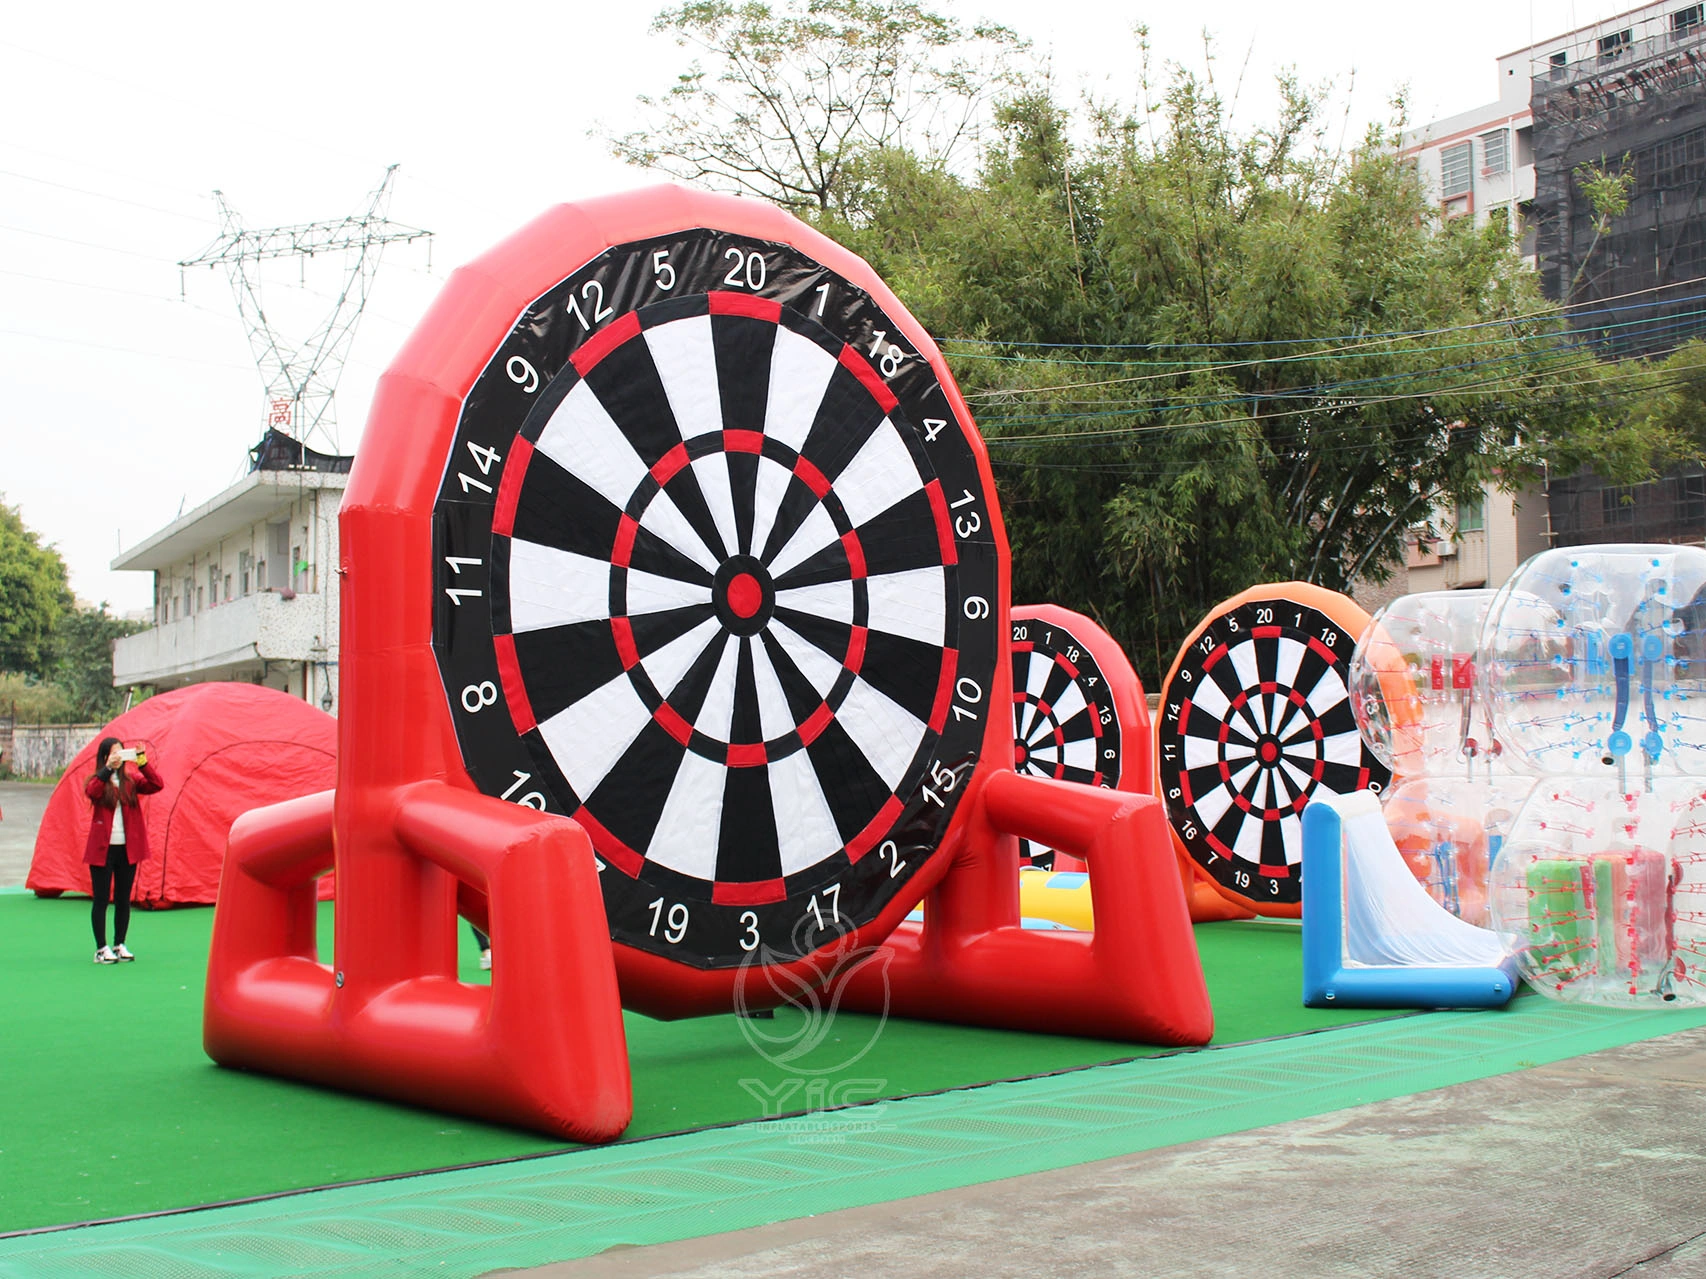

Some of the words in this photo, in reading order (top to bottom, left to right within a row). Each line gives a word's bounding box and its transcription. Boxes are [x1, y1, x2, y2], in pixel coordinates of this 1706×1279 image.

[654, 250, 675, 290] 5
[724, 248, 766, 290] 20
[567, 280, 613, 330] 12
[815, 283, 830, 317] 1
[869, 330, 903, 378] 18
[507, 356, 538, 393] 9
[923, 419, 947, 441] 4
[458, 441, 501, 493] 14
[951, 490, 980, 538] 13
[446, 557, 482, 605] 11
[964, 596, 989, 619] 6
[1256, 607, 1273, 624] 20
[1228, 617, 1239, 633] 5
[1294, 612, 1302, 628] 1
[1013, 626, 1028, 641] 20
[1045, 631, 1052, 645] 1
[1320, 627, 1337, 647] 18
[1065, 645, 1080, 664] 18
[1199, 635, 1216, 655] 12
[1087, 677, 1098, 687] 4
[1181, 669, 1192, 683] 9
[462, 681, 497, 712] 8
[952, 678, 981, 721] 10
[1098, 705, 1112, 725] 13
[1167, 703, 1181, 721] 14
[1103, 749, 1116, 759] 6
[1164, 744, 1176, 761] 11
[922, 760, 956, 807] 15
[1169, 787, 1181, 799] 8
[1367, 780, 1383, 794] 0
[1181, 819, 1198, 840] 16
[880, 841, 906, 878] 2
[1207, 851, 1219, 865] 7
[1234, 870, 1250, 888] 19
[1270, 879, 1279, 895] 3
[807, 883, 840, 930] 17
[649, 898, 688, 943] 19
[740, 912, 759, 950] 3
